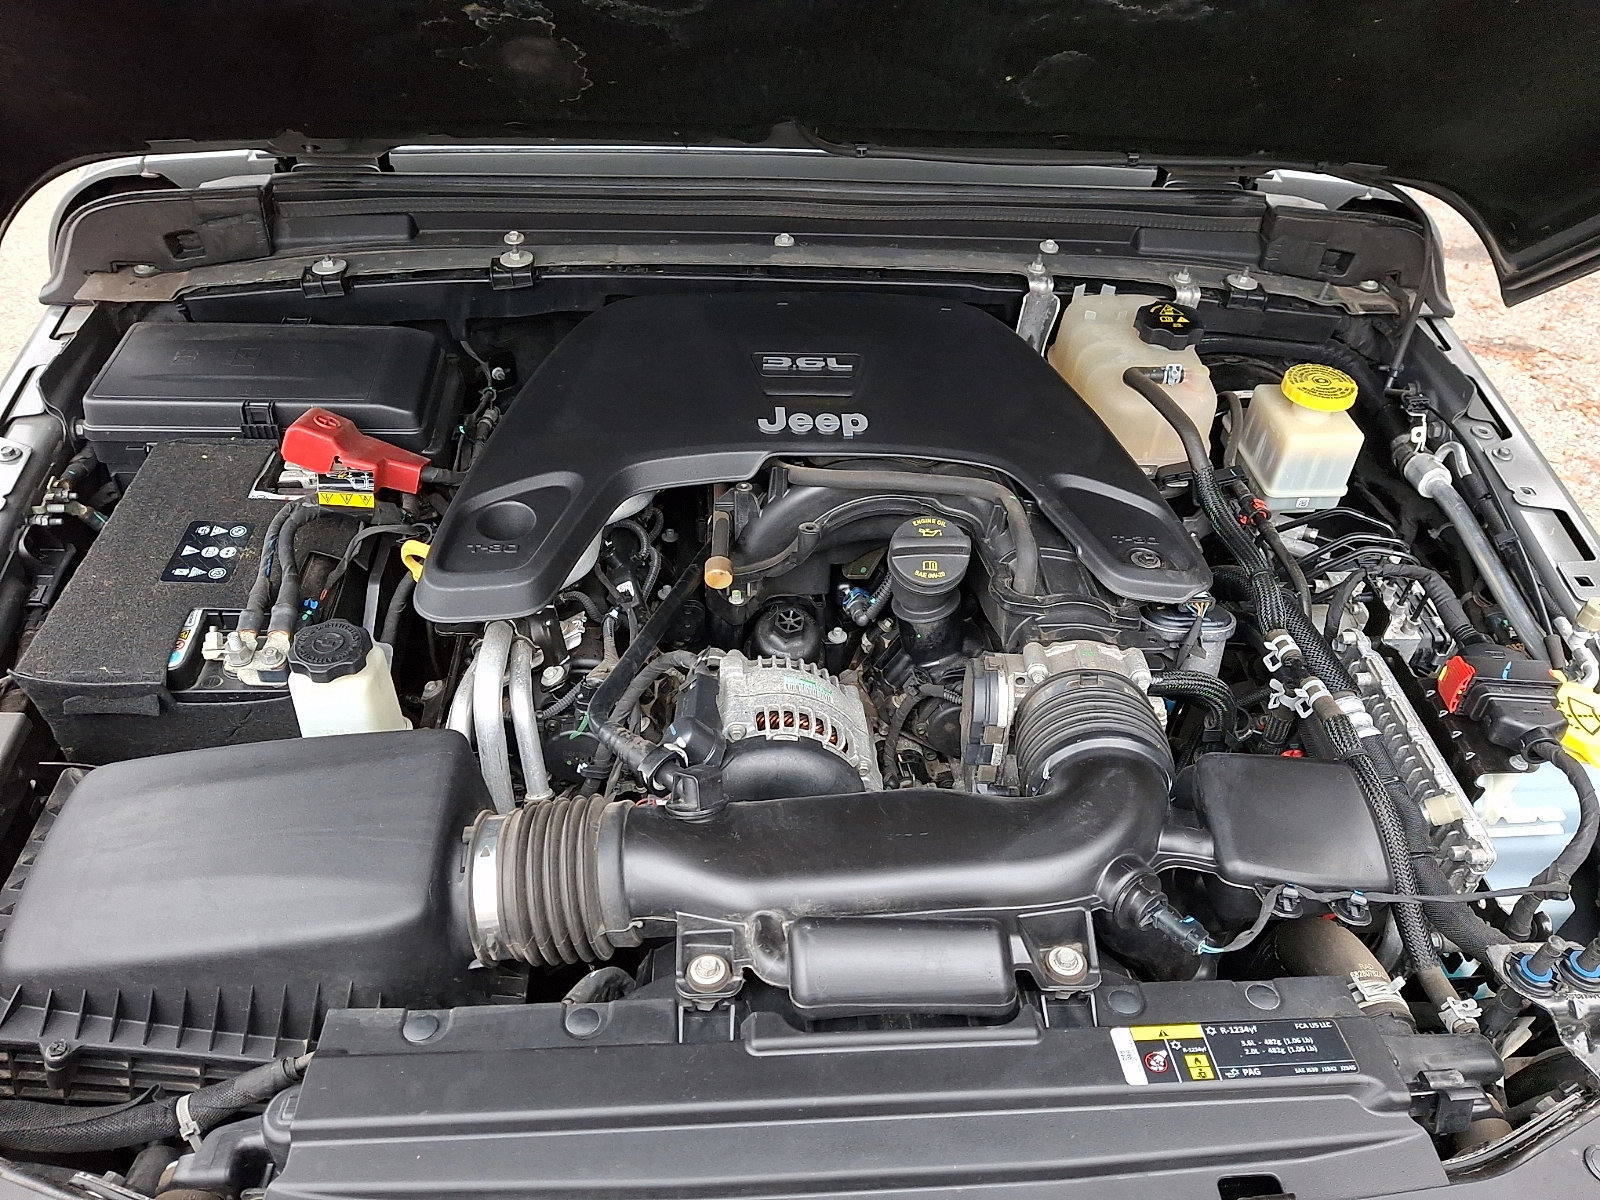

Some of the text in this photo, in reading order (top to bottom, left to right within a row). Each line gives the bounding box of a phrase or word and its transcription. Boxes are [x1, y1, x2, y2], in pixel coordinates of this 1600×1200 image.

[762, 356, 853, 371] 3.6L
[757, 406, 869, 439] Jeep
[912, 518, 946, 527] ENGINE OIL
[914, 570, 946, 579] SAE 0W-20
[1219, 1025, 1258, 1035] R-1234yf
[1295, 1022, 1309, 1030] FCA
[1320, 1021, 1333, 1029] LLC
[1264, 1038, 1282, 1046] 482g
[1283, 1037, 1301, 1046] (1.06
[1287, 1046, 1305, 1054] (1.06
[1242, 1068, 1261, 1076] PAG
